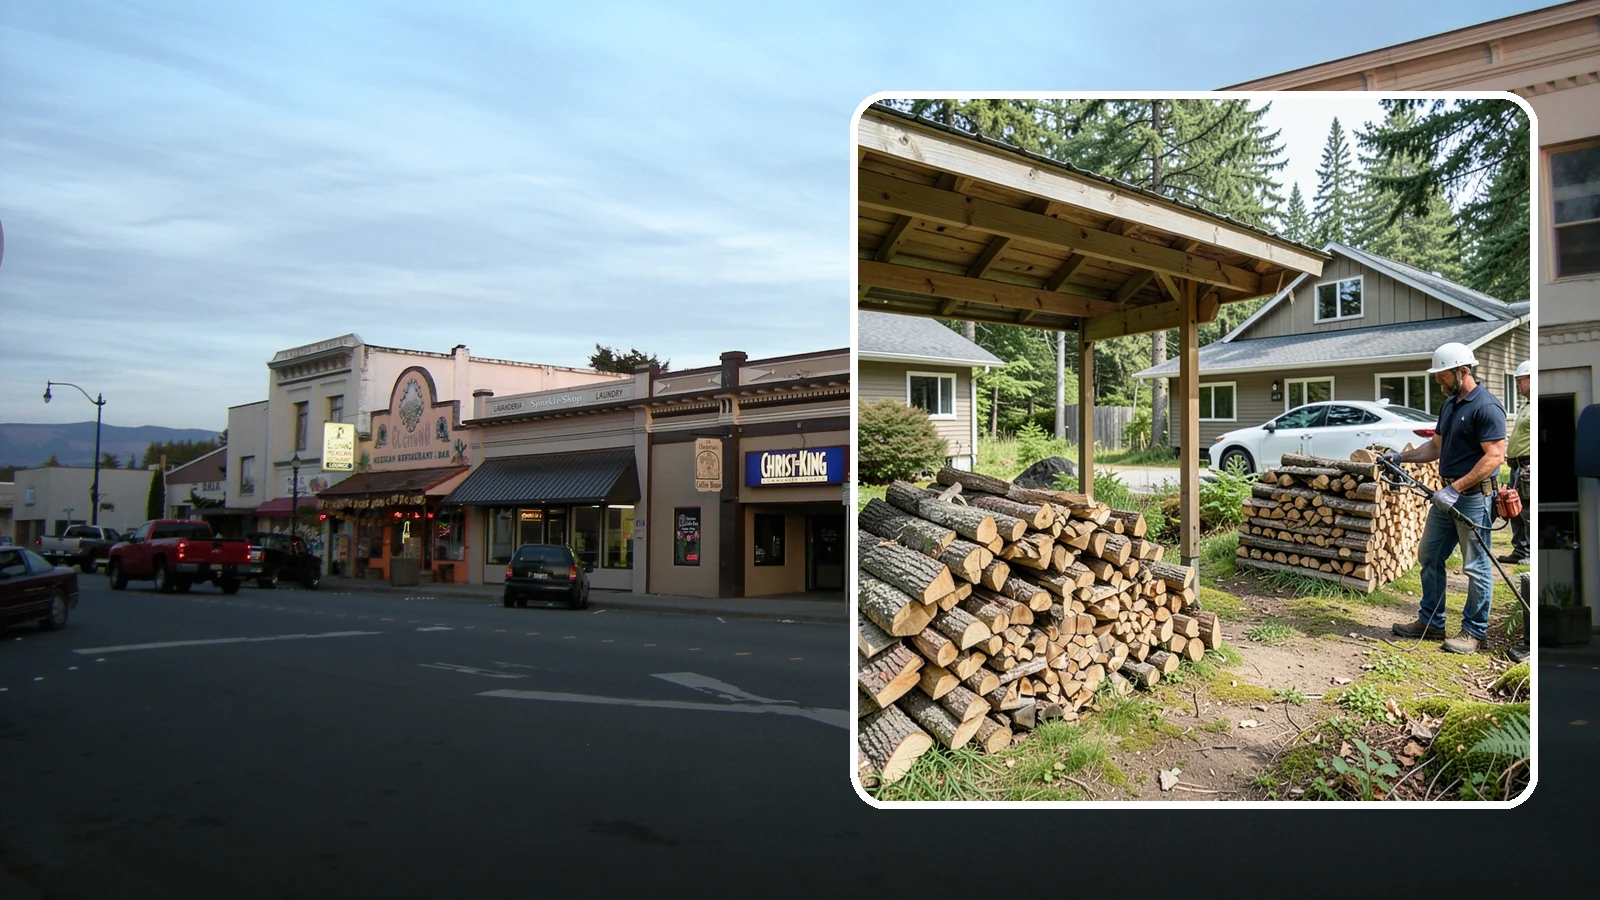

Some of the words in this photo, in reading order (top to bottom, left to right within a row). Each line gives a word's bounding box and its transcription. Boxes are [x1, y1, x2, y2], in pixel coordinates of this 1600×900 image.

[595, 388, 624, 399] LAUNDRY
[562, 394, 583, 405] Shop
[493, 402, 522, 412] LAVANDERIA
[374, 455, 396, 464] MEXICAN
[398, 451, 433, 462] RESTAURANT
[438, 450, 450, 459] BAR
[760, 452, 797, 478] CHRIST
[799, 450, 827, 476] KING
